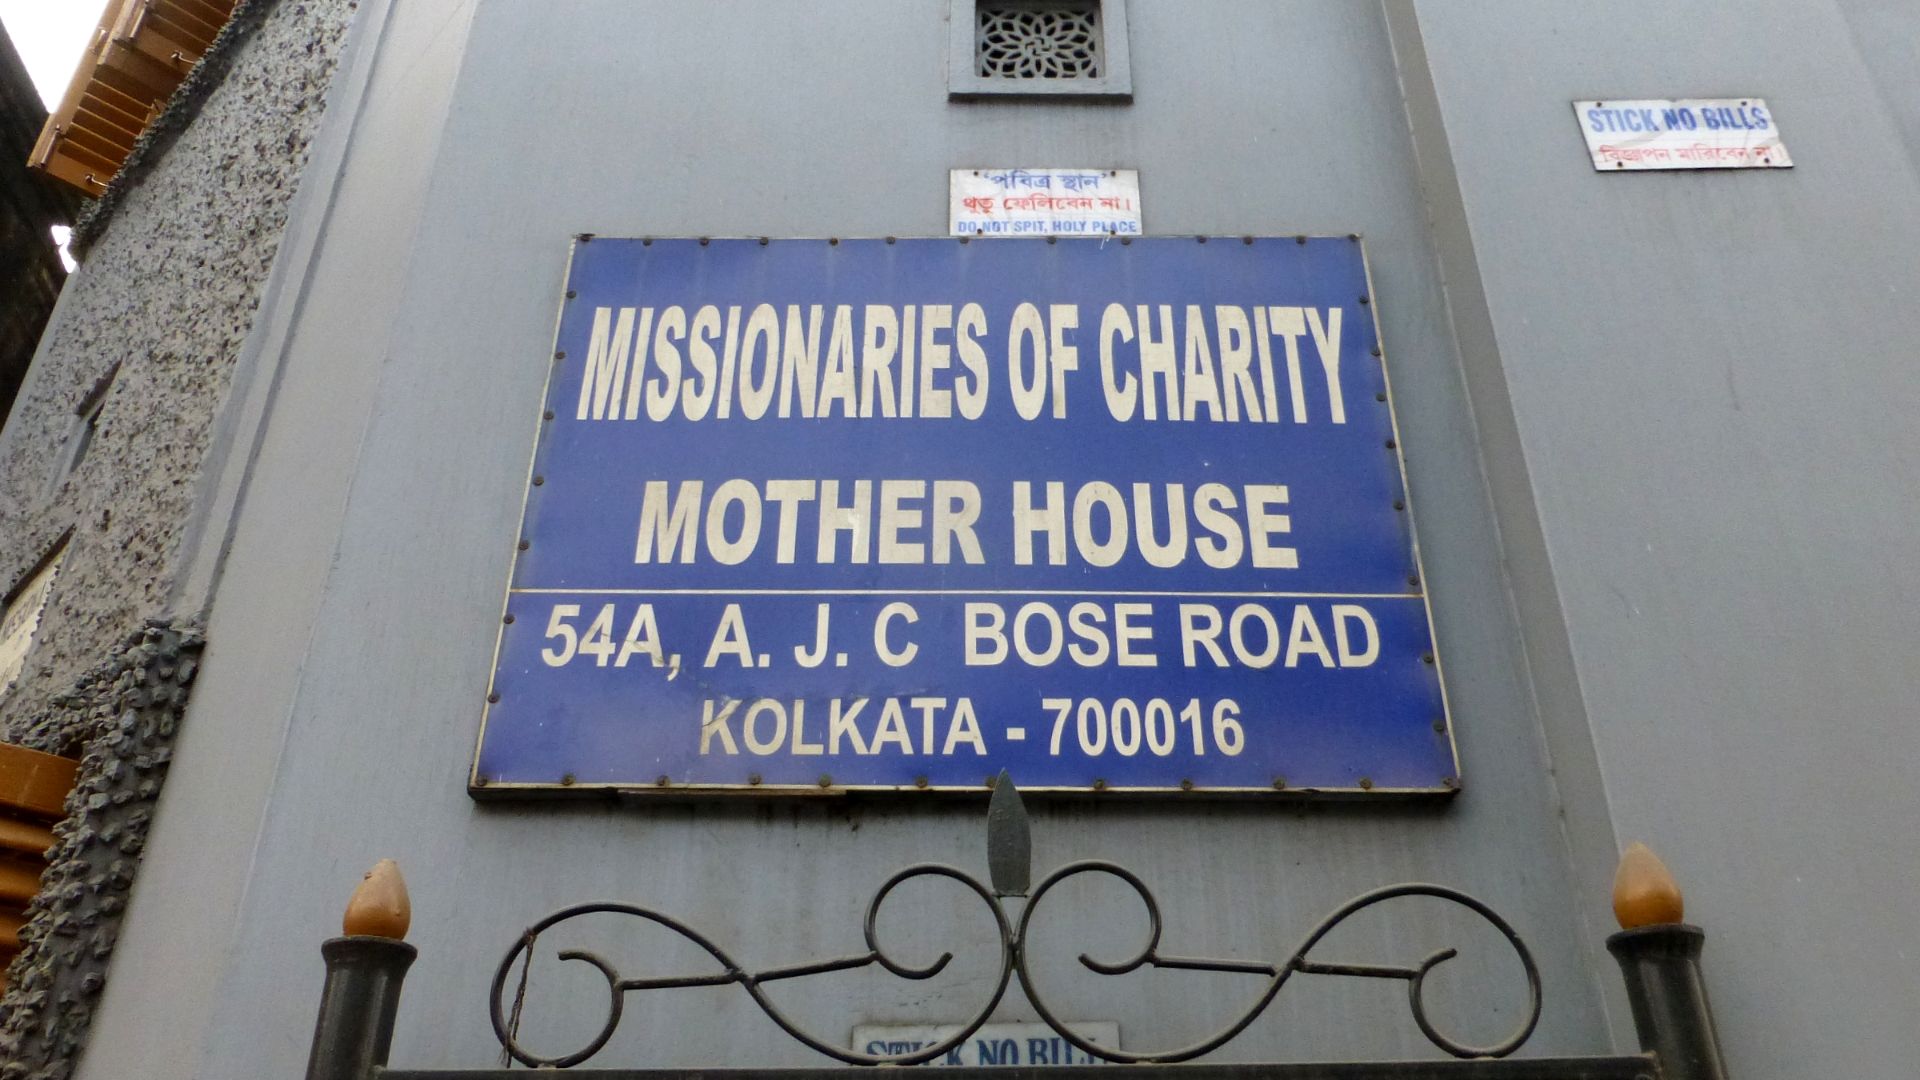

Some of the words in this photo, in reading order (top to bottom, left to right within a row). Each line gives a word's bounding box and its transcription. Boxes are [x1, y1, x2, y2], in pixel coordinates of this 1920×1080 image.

[1587, 108, 1660, 133] STICK
[1663, 108, 1697, 131] NO
[1700, 107, 1769, 130] BILLS
[958, 221, 977, 233] DO
[982, 221, 1009, 232] NOT
[1014, 221, 1048, 233] SPIT,
[1052, 221, 1087, 232] HOLY
[1093, 221, 1137, 233] PLACE
[576, 302, 989, 421] MISSIONARIES
[1008, 302, 1079, 421] OF
[1099, 302, 1346, 424] CHARITY
[634, 479, 986, 566] MOTHER
[1012, 480, 1299, 569] HOUSE
[541, 603, 682, 681] 54A,
[703, 603, 772, 668] A.
[794, 603, 849, 668] J.
[873, 602, 919, 668] C
[964, 601, 1158, 668] BOSE
[1179, 603, 1380, 669] ROAD
[699, 697, 987, 756] KOLKATA
[1006, 727, 1025, 740] -
[1042, 697, 1245, 756] 700016
[976, 1040, 1019, 1066] NO
